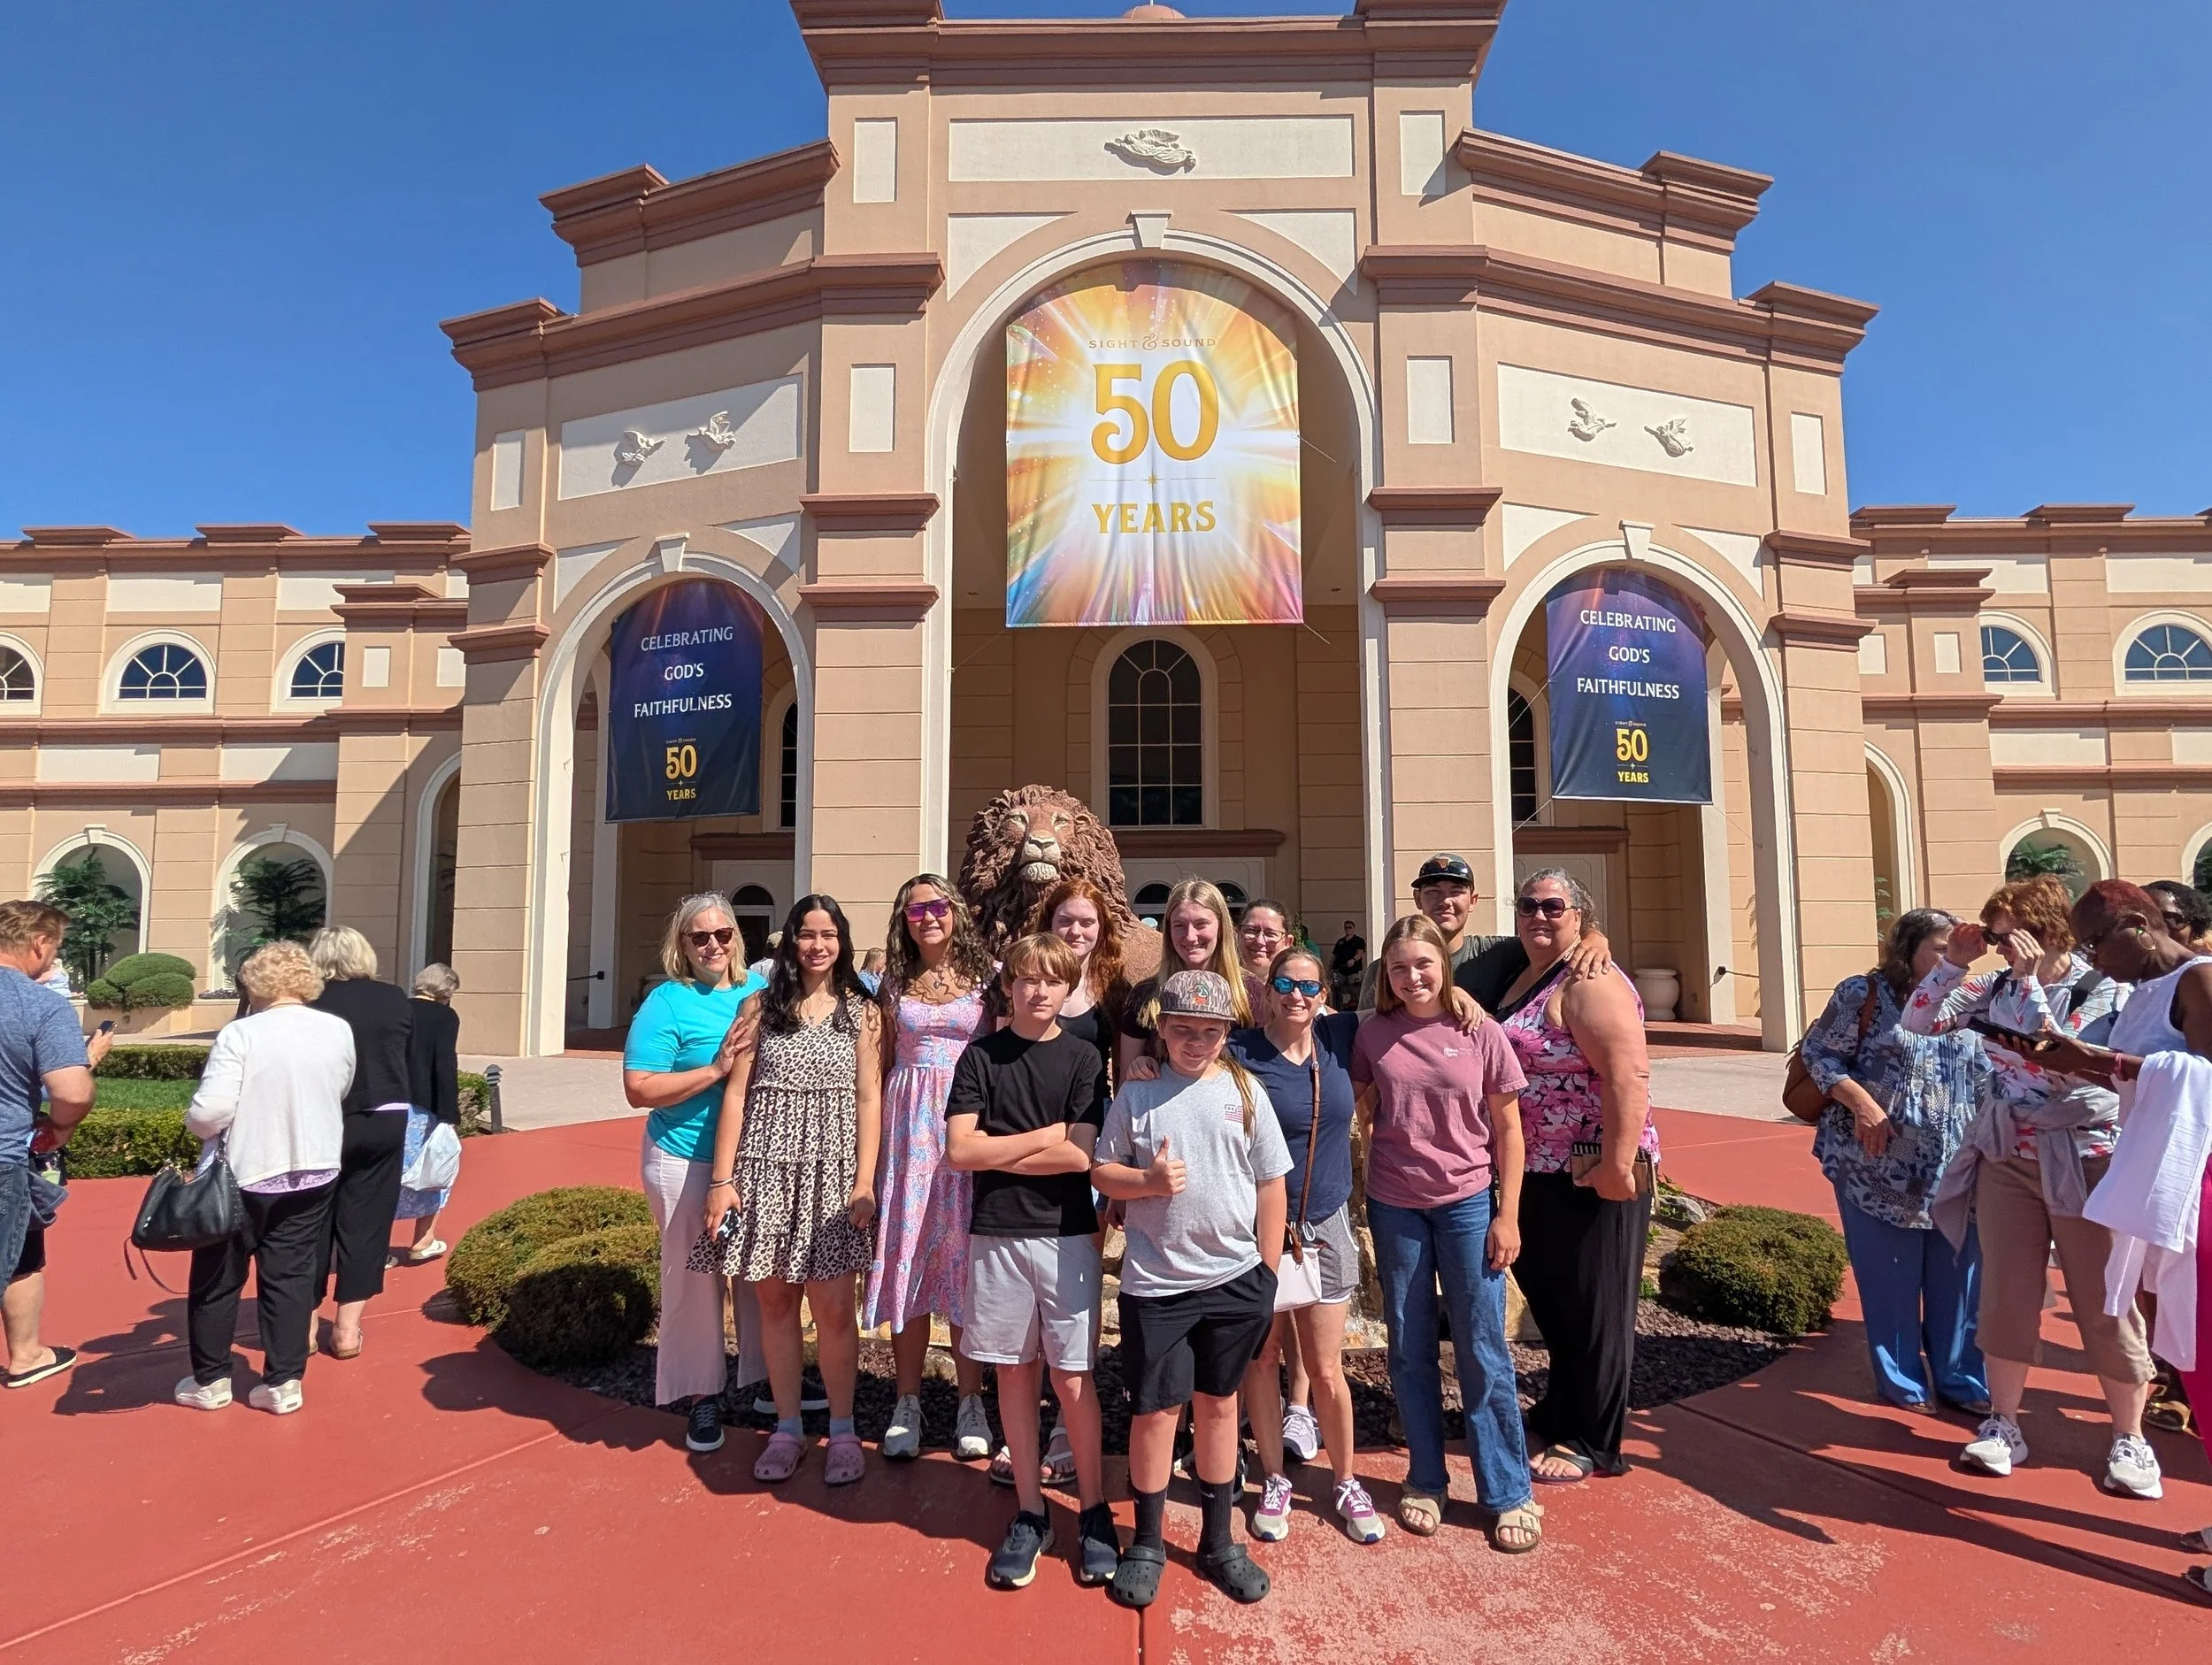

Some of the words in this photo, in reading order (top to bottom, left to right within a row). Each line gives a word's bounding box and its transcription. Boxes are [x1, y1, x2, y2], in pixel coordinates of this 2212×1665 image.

[1088, 340, 1139, 349] SIGHT
[1142, 334, 1158, 350] &
[1162, 338, 1216, 348] SOUND
[1090, 359, 1219, 464] 50
[1091, 501, 1216, 533] YEARS
[1579, 610, 1676, 633] CELEBRATING
[641, 626, 733, 651] CELEBRATING
[1609, 647, 1650, 664] GOD'S
[664, 663, 704, 681] GOD'S
[1577, 678, 1679, 700] FAITHFULNESS
[634, 694, 733, 717] FAITHFULNESS
[1616, 728, 1648, 762] 50
[665, 744, 697, 779] 50
[1617, 771, 1649, 783] YEARS
[666, 788, 696, 801] YEARS
